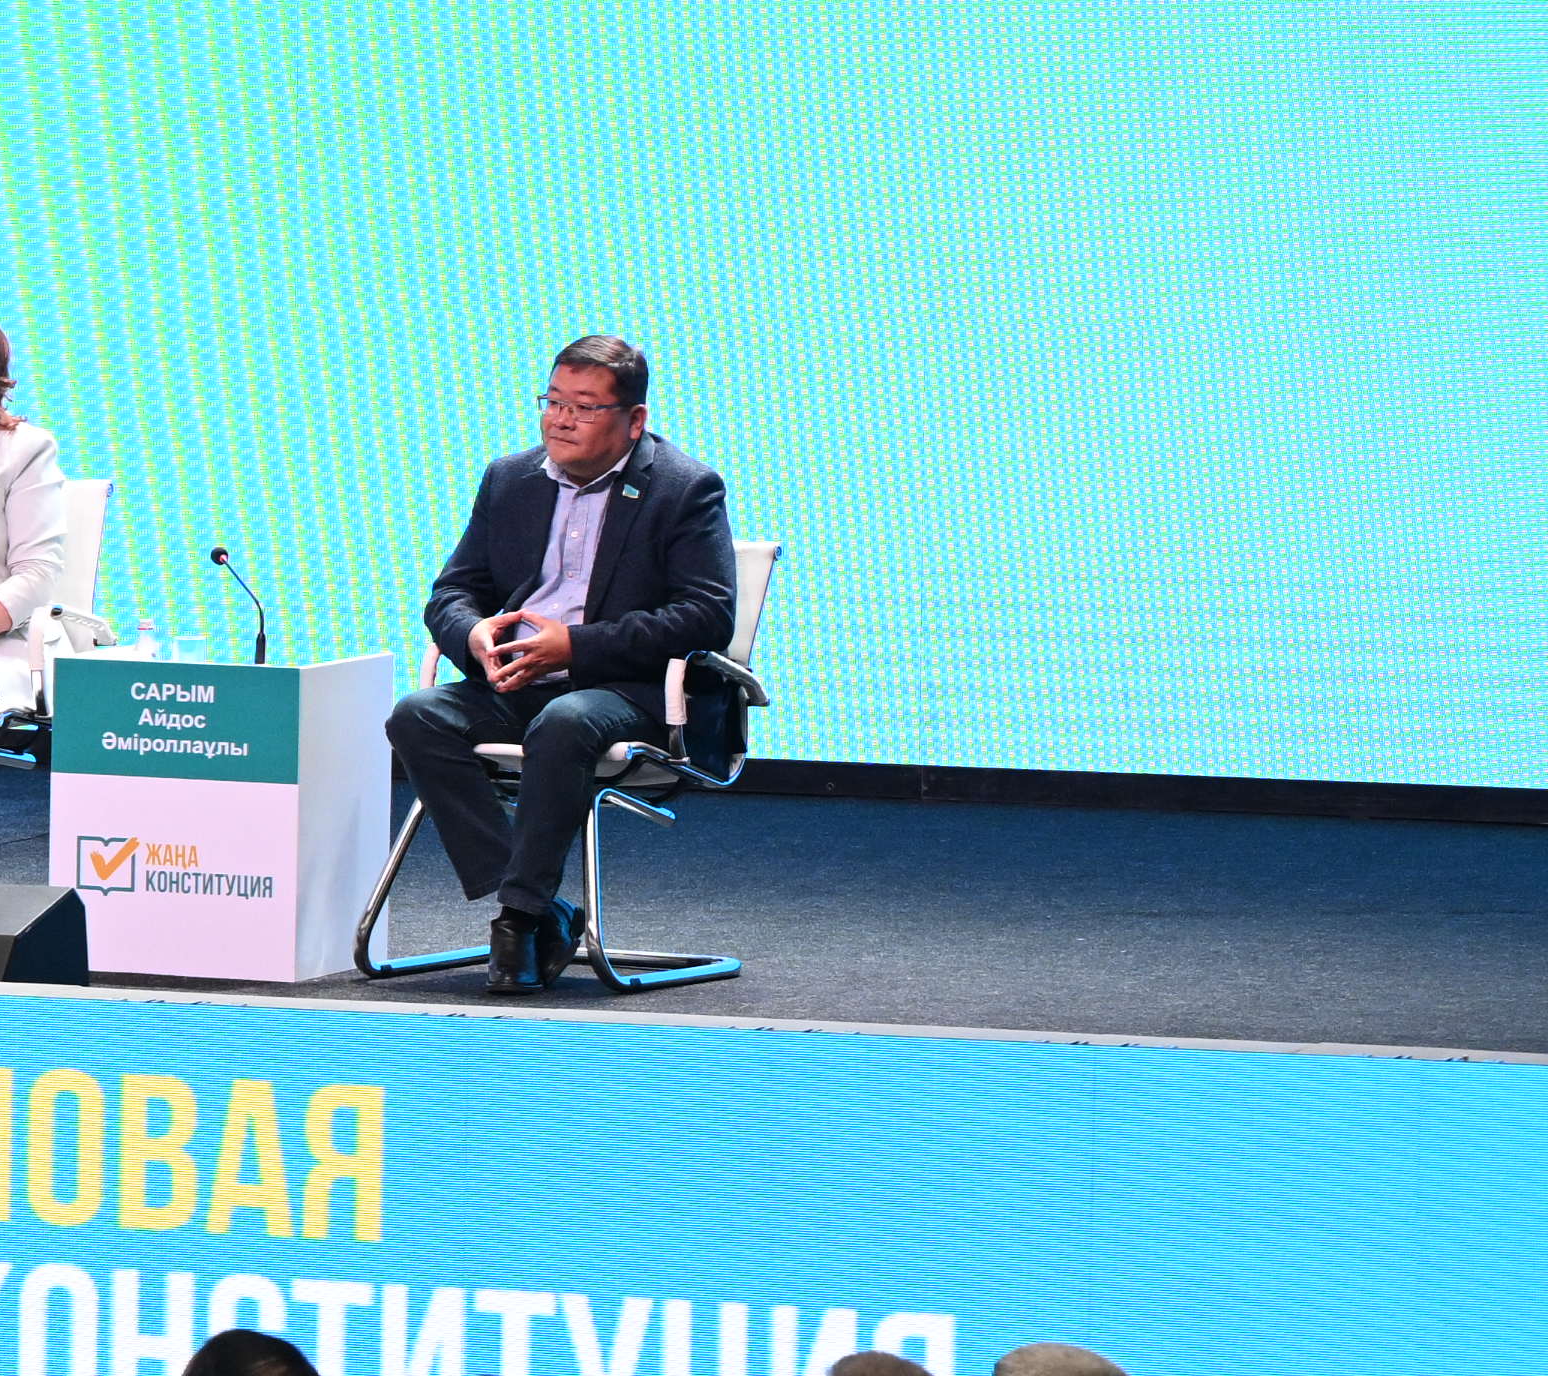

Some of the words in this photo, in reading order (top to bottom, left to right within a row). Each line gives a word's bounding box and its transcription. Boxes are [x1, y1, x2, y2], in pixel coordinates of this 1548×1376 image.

[130, 682, 215, 704] САРЫМ
[138, 708, 206, 730] Айдос
[101, 732, 249, 759] Әміроллаұлы
[145, 843, 199, 869] ЖАҢА
[145, 870, 273, 900] КОНСТИТУЦИЯ
